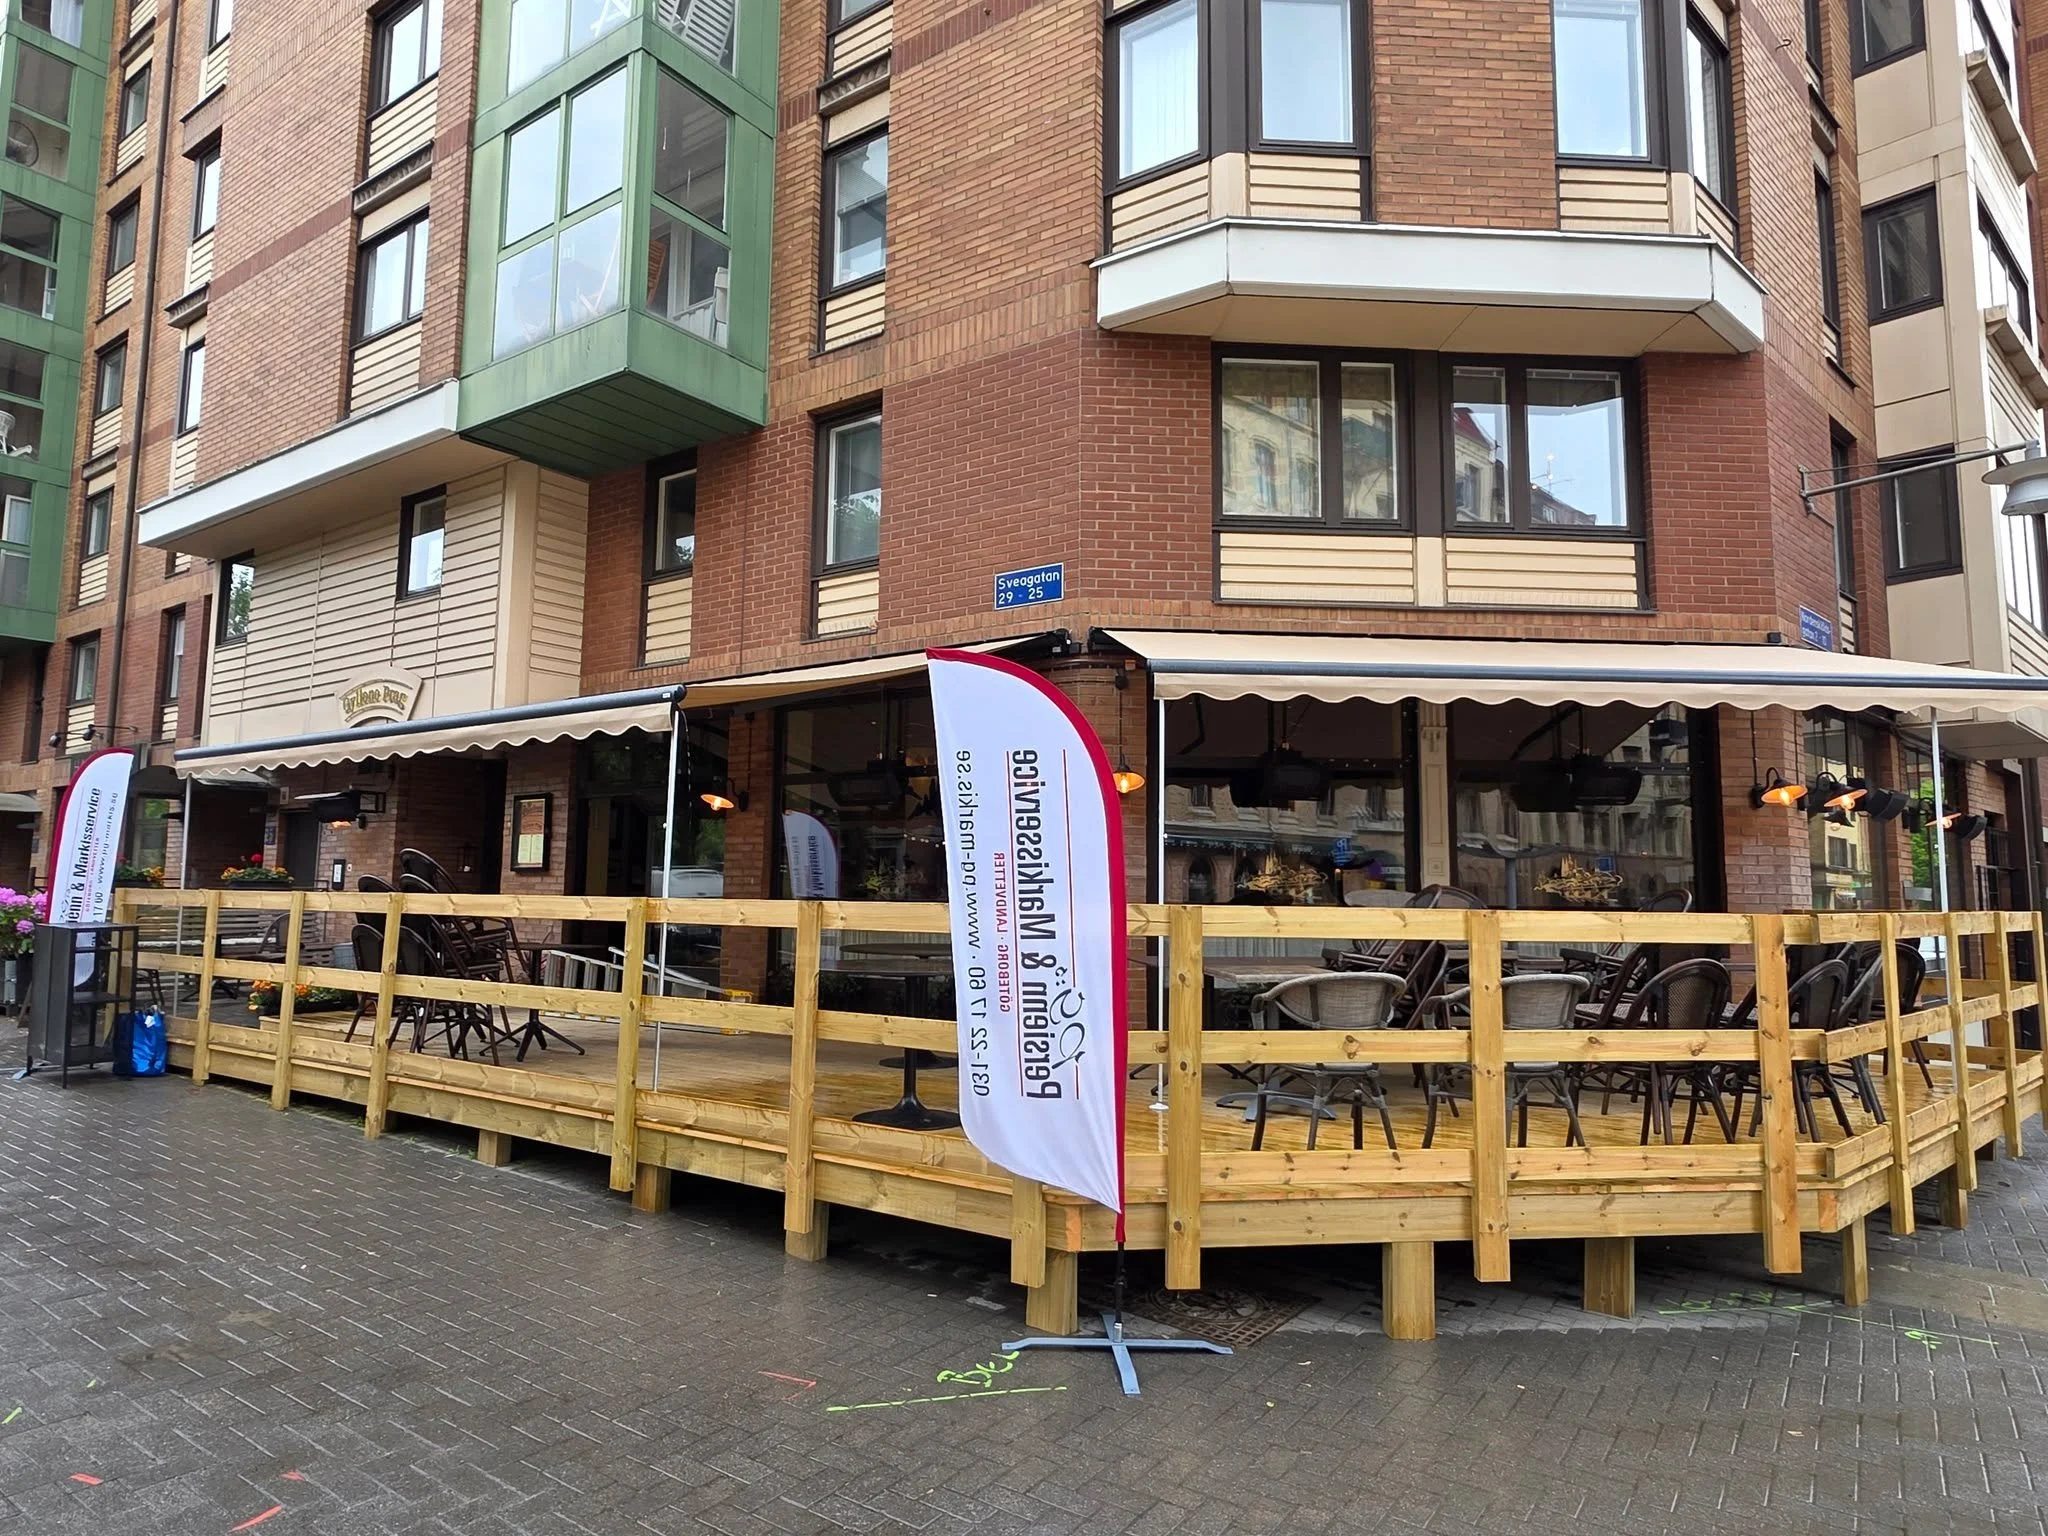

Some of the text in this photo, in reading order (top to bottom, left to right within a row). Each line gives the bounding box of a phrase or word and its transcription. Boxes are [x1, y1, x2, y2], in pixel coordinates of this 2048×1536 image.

[998, 571, 1060, 590] Sveagatan
[998, 591, 1014, 605] 29
[1028, 586, 1044, 600] 25
[73, 788, 101, 878] Markisservice
[71, 881, 85, 891] &
